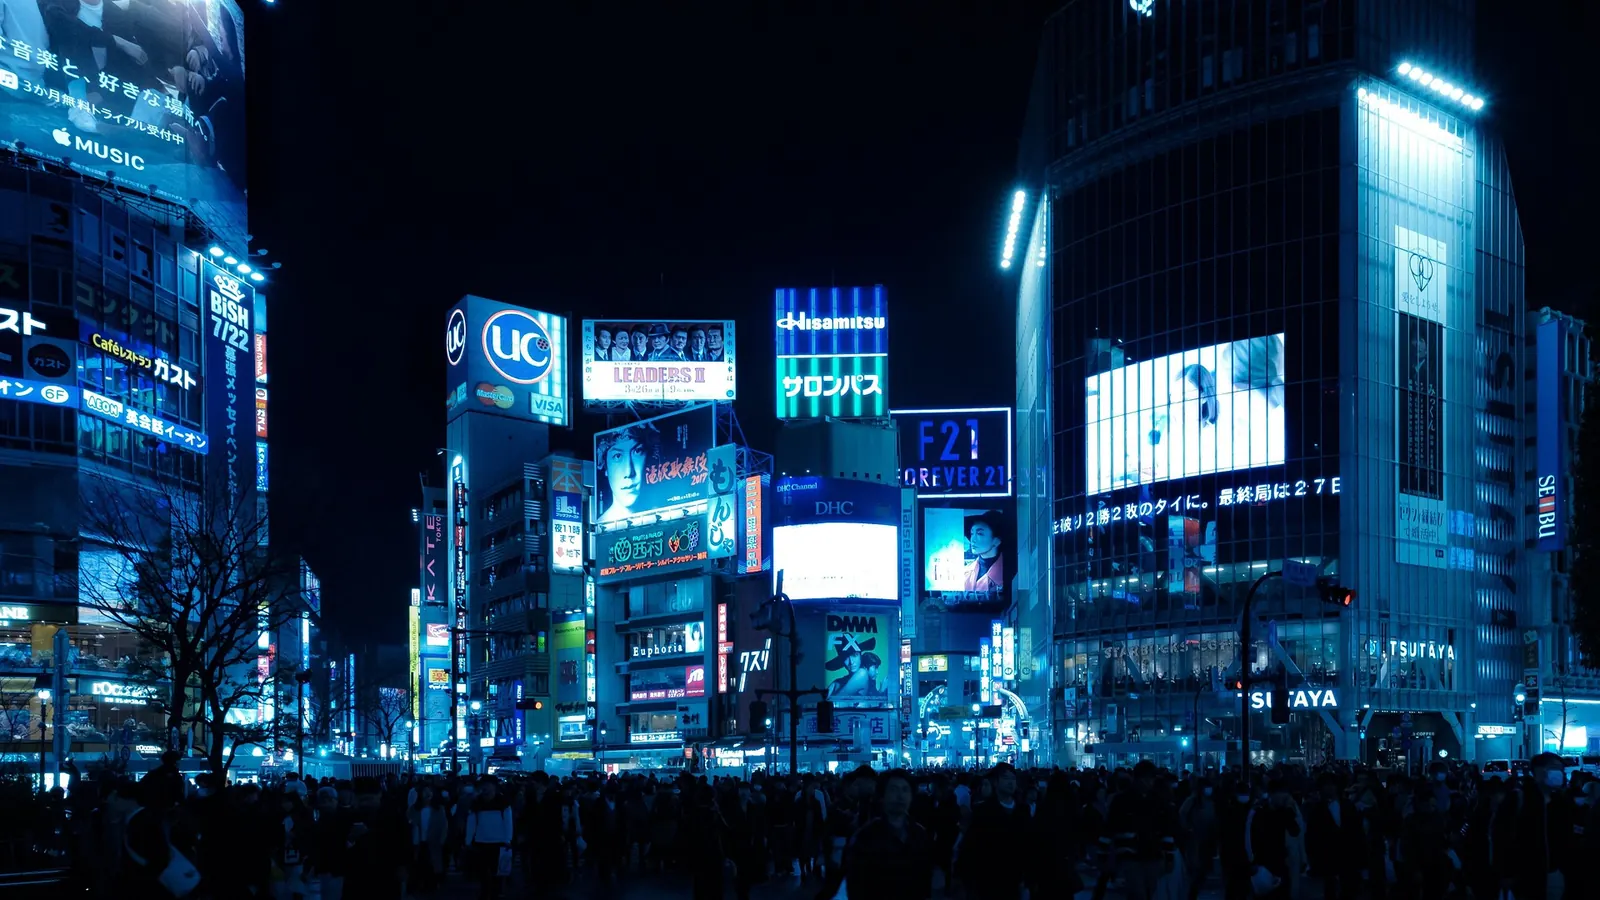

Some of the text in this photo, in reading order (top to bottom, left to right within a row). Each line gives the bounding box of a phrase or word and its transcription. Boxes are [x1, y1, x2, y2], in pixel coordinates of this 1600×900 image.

[75, 135, 145, 171] MUSIC
[210, 289, 249, 331] BiSH
[776, 311, 886, 331] Hisamitsu
[211, 314, 249, 352] 7/22
[33, 357, 66, 369] ガスト
[153, 357, 196, 391] ガスト
[613, 366, 692, 383] LEADERS
[45, 388, 65, 400] 6F
[782, 374, 882, 397] サロンパス
[476, 388, 515, 403] MasterCard
[535, 398, 563, 414] VISA
[86, 395, 207, 448] AEON 英会話イーオン
[920, 418, 979, 461] F21
[898, 465, 1005, 488] OREVER 21
[791, 482, 818, 491] Channel
[709, 457, 735, 553] もんじゃ
[815, 501, 854, 516] DHC
[554, 523, 581, 535] 夜11時
[559, 534, 575, 545] まで
[632, 537, 664, 560] 西村
[566, 548, 581, 559] 地下
[903, 561, 913, 598] neon
[826, 615, 878, 634] DMM
[633, 643, 683, 658] Euphoria
[827, 634, 862, 651] FX
[739, 638, 771, 693] クスリ
